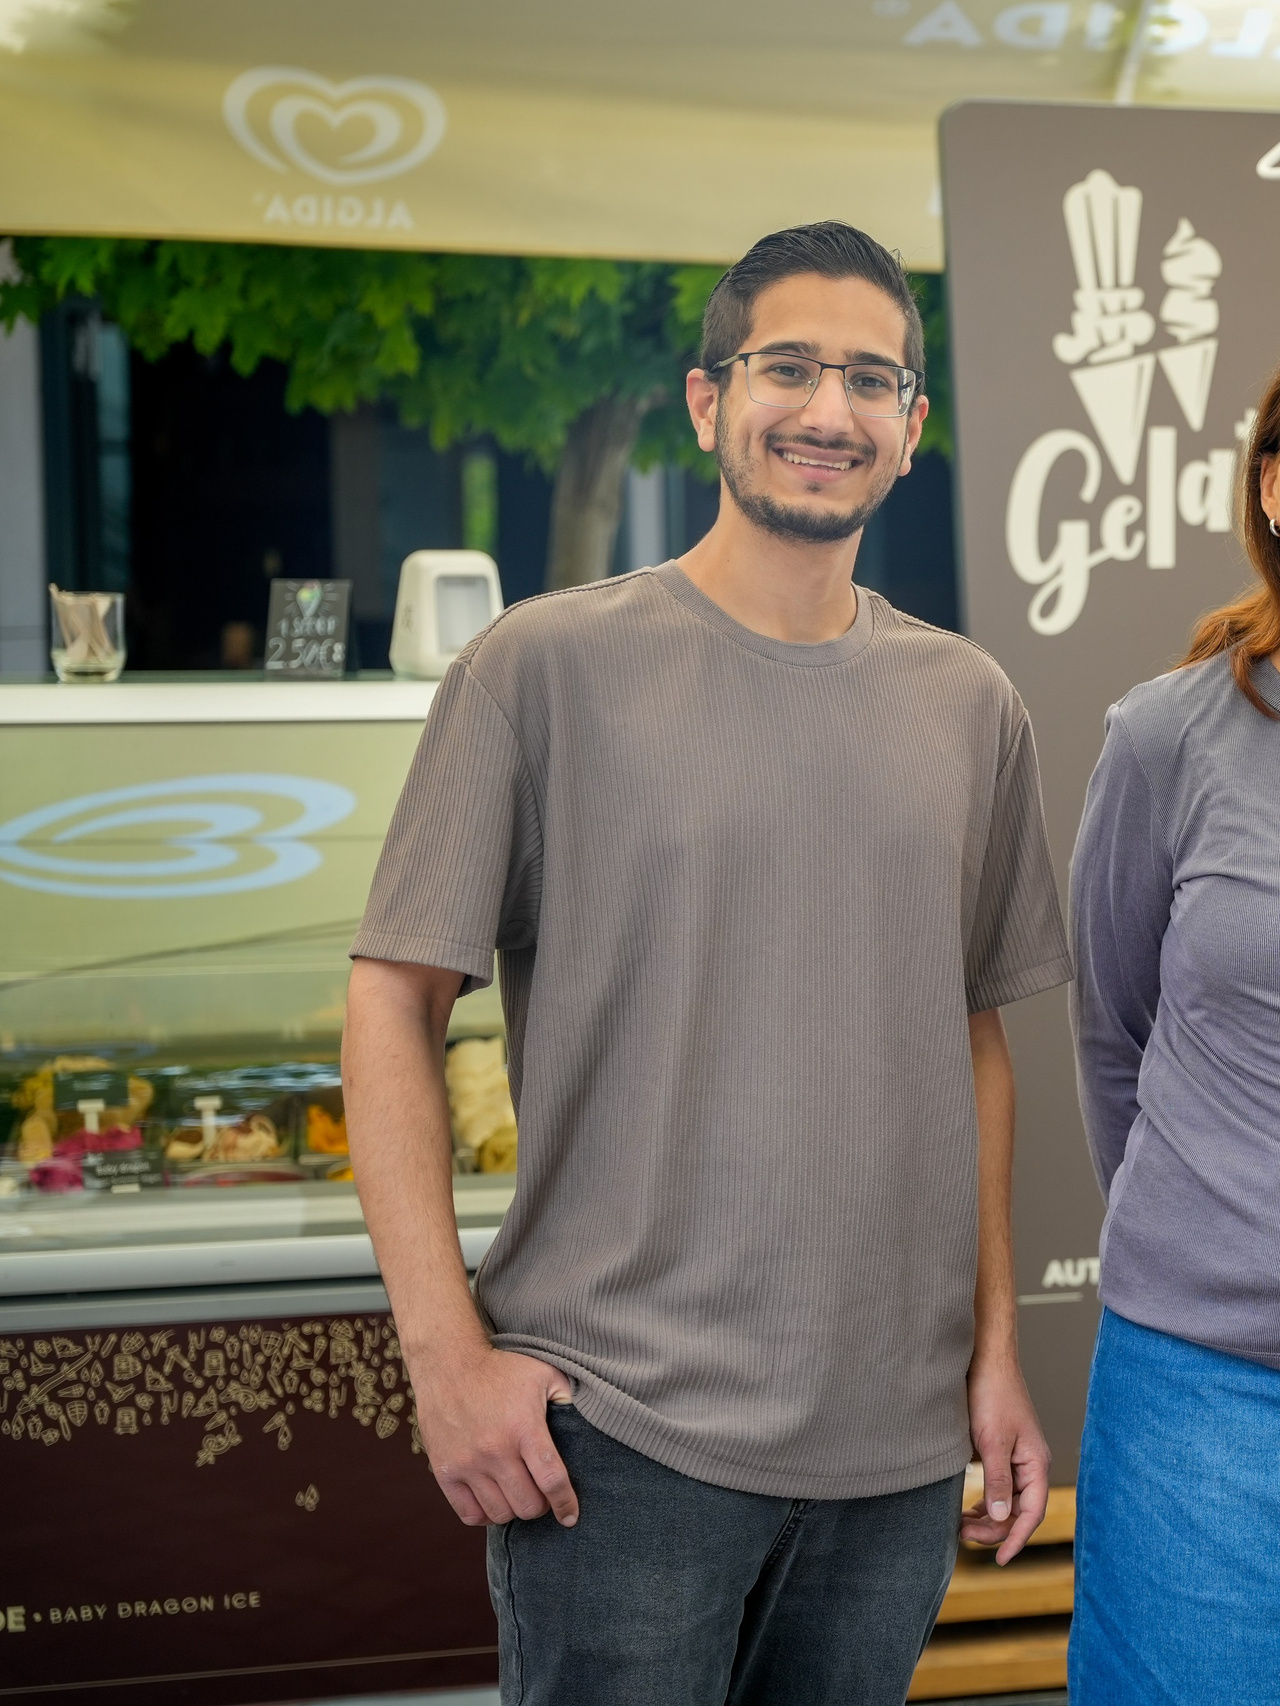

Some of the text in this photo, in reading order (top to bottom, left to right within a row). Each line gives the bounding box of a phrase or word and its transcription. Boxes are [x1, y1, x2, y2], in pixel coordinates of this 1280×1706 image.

[50, 1604, 107, 1624] BABY
[117, 1595, 214, 1619] DRAGON
[223, 1591, 261, 1610] ICE
